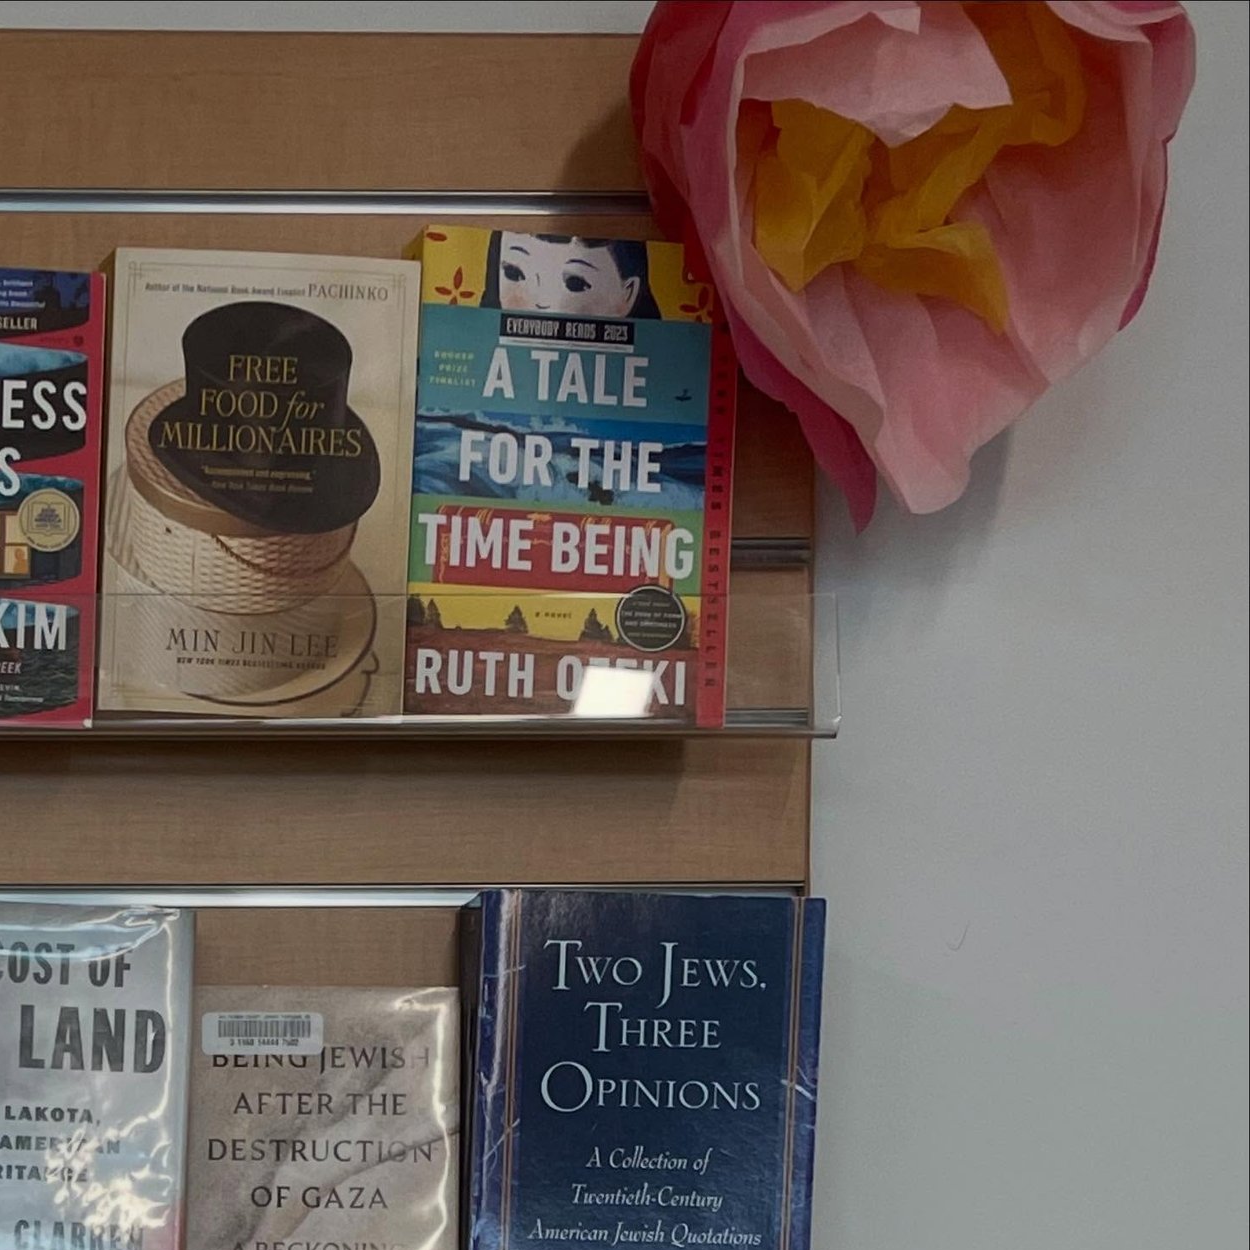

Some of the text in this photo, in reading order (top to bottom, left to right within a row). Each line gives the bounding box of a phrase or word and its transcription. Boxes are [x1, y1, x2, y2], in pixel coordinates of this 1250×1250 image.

[308, 283, 388, 301] PACHINKO
[506, 318, 629, 341] EVERYBODY READS 2023
[228, 354, 298, 384] FREE
[483, 347, 649, 408] A TALE
[200, 388, 324, 432] FOOD for
[158, 421, 363, 457] MILLIONAIRES
[459, 429, 664, 492] FOR THE
[418, 513, 694, 580] TIME BEING
[705, 531, 721, 688] BESTSELLER
[165, 627, 338, 658] MIN JIN LEE
[415, 648, 686, 706] RUTH OKI
[19, 1004, 166, 1074] LAND
[319, 1046, 430, 1074] JEWISH
[4, 1105, 101, 1126] LAKOTA,
[233, 1092, 407, 1116] AFTER THE
[208, 1138, 433, 1163] DESTRUCTION
[585, 1145, 714, 1175] A Collection of
[251, 1186, 386, 1209] OF GAZA
[571, 1182, 723, 1213] Twentieth-Century
[527, 1218, 762, 1248] American Jewish Quotations
